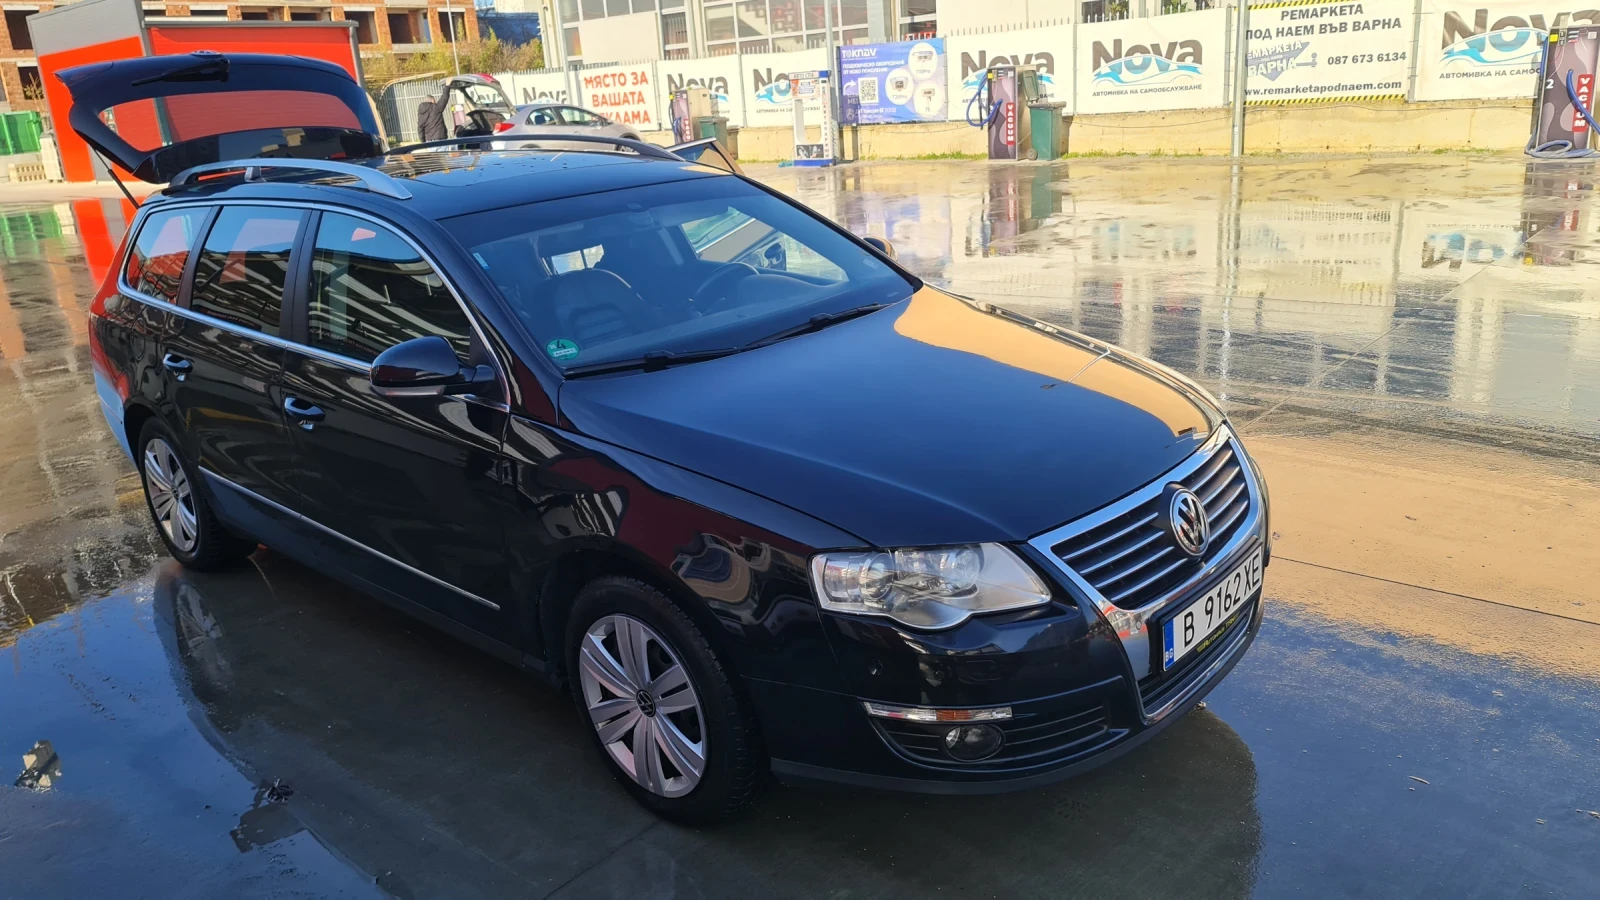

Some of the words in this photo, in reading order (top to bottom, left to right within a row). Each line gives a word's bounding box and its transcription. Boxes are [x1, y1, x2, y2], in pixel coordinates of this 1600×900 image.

[1280, 4, 1363, 21] РЕМАРКЕТА
[1245, 29, 1272, 41] ПОД
[1276, 25, 1314, 38] НАЕМ
[1319, 21, 1348, 35] ВЪВ
[1352, 18, 1402, 32] ВАРНА
[1092, 38, 1202, 75] Nova
[1247, 40, 1302, 60] ЕМАРКЕТА
[1327, 55, 1349, 66] 087
[1352, 53, 1374, 64] 673
[1377, 51, 1407, 63] 6134
[1247, 57, 1297, 77] ВАРНА
[1439, 70, 1492, 79] АВТОМИВКА
[583, 72, 627, 90] МЯСТО
[631, 70, 649, 86] ЗА
[1245, 81, 1402, 96] ww.remarketapodnaem.com
[1546, 79, 1554, 89] 2
[591, 90, 645, 107] ВАШАТА
[1092, 89, 1128, 97] АВТОМИВКА
[1140, 84, 1202, 94] САМООБСЛУЖВАНЕ
[557, 339, 566, 349] 4
[1184, 610, 1195, 648] B
[1205, 572, 1241, 630] 9162
[1244, 553, 1260, 597] XE
[1165, 647, 1174, 662] BG
